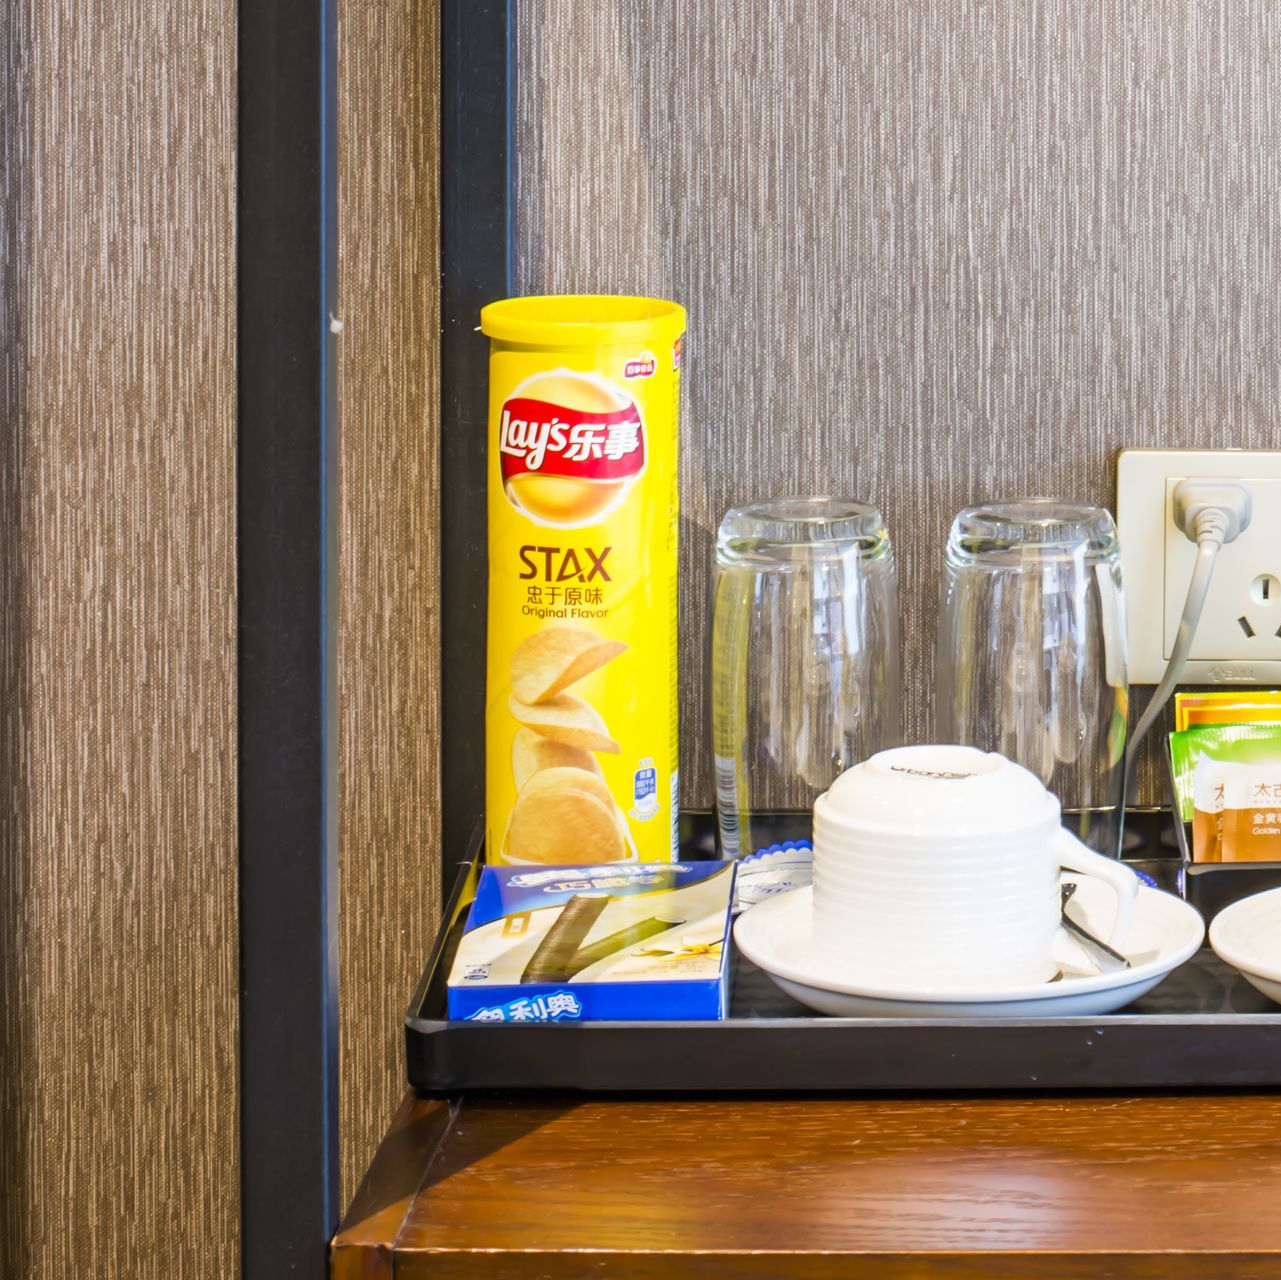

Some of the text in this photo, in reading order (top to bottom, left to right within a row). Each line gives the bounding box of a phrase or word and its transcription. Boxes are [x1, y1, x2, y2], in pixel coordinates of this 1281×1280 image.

[500, 410, 641, 470] Lay's 乐事
[519, 545, 612, 583] STAX
[527, 585, 604, 606] 忠于原味
[521, 605, 608, 620] Original Flavor
[1252, 826, 1281, 836] Golden
